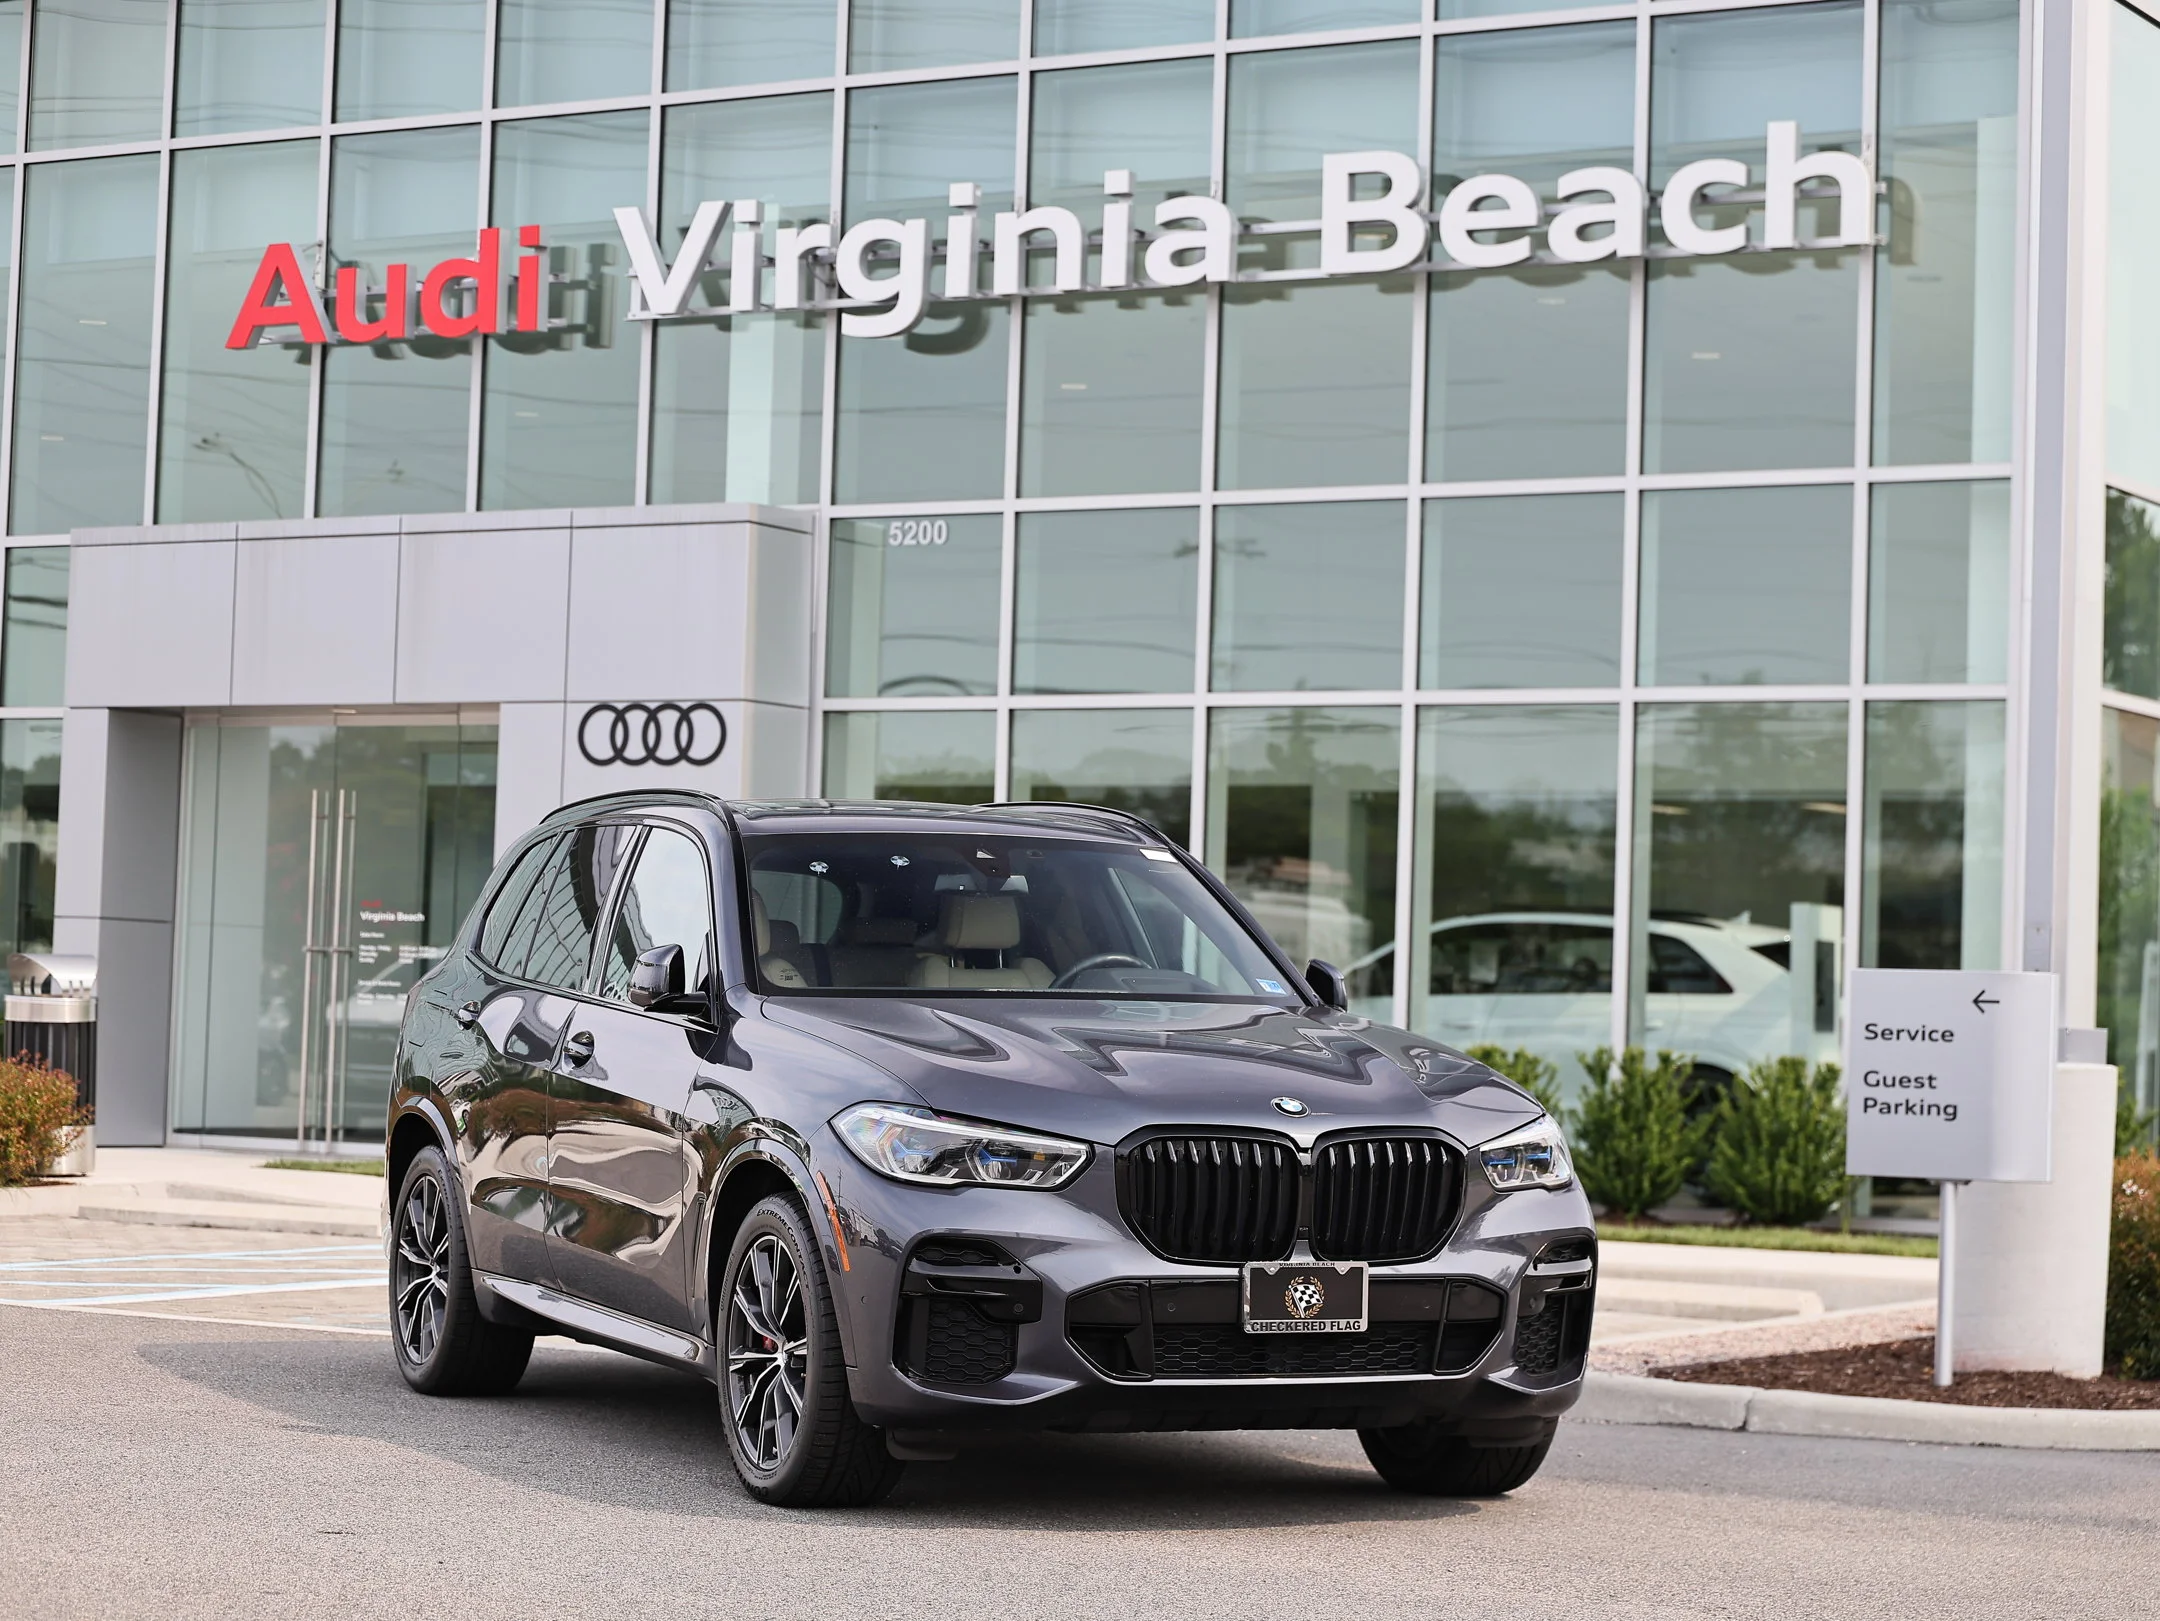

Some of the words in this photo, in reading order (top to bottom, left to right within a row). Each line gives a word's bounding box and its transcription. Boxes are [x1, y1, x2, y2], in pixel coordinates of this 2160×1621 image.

[225, 225, 546, 349] Audi
[613, 169, 1237, 338] Virginia
[1321, 120, 1876, 276] Beach
[888, 520, 948, 546] 5200
[360, 910, 396, 923] Virginia
[396, 911, 425, 922] Beach
[1864, 1023, 1955, 1043] Service
[1863, 1070, 1938, 1090] Guest
[1863, 1097, 1959, 1122] Parking
[1250, 1321, 1326, 1332] CHECKERED
[1330, 1320, 1361, 1331] FLAG
